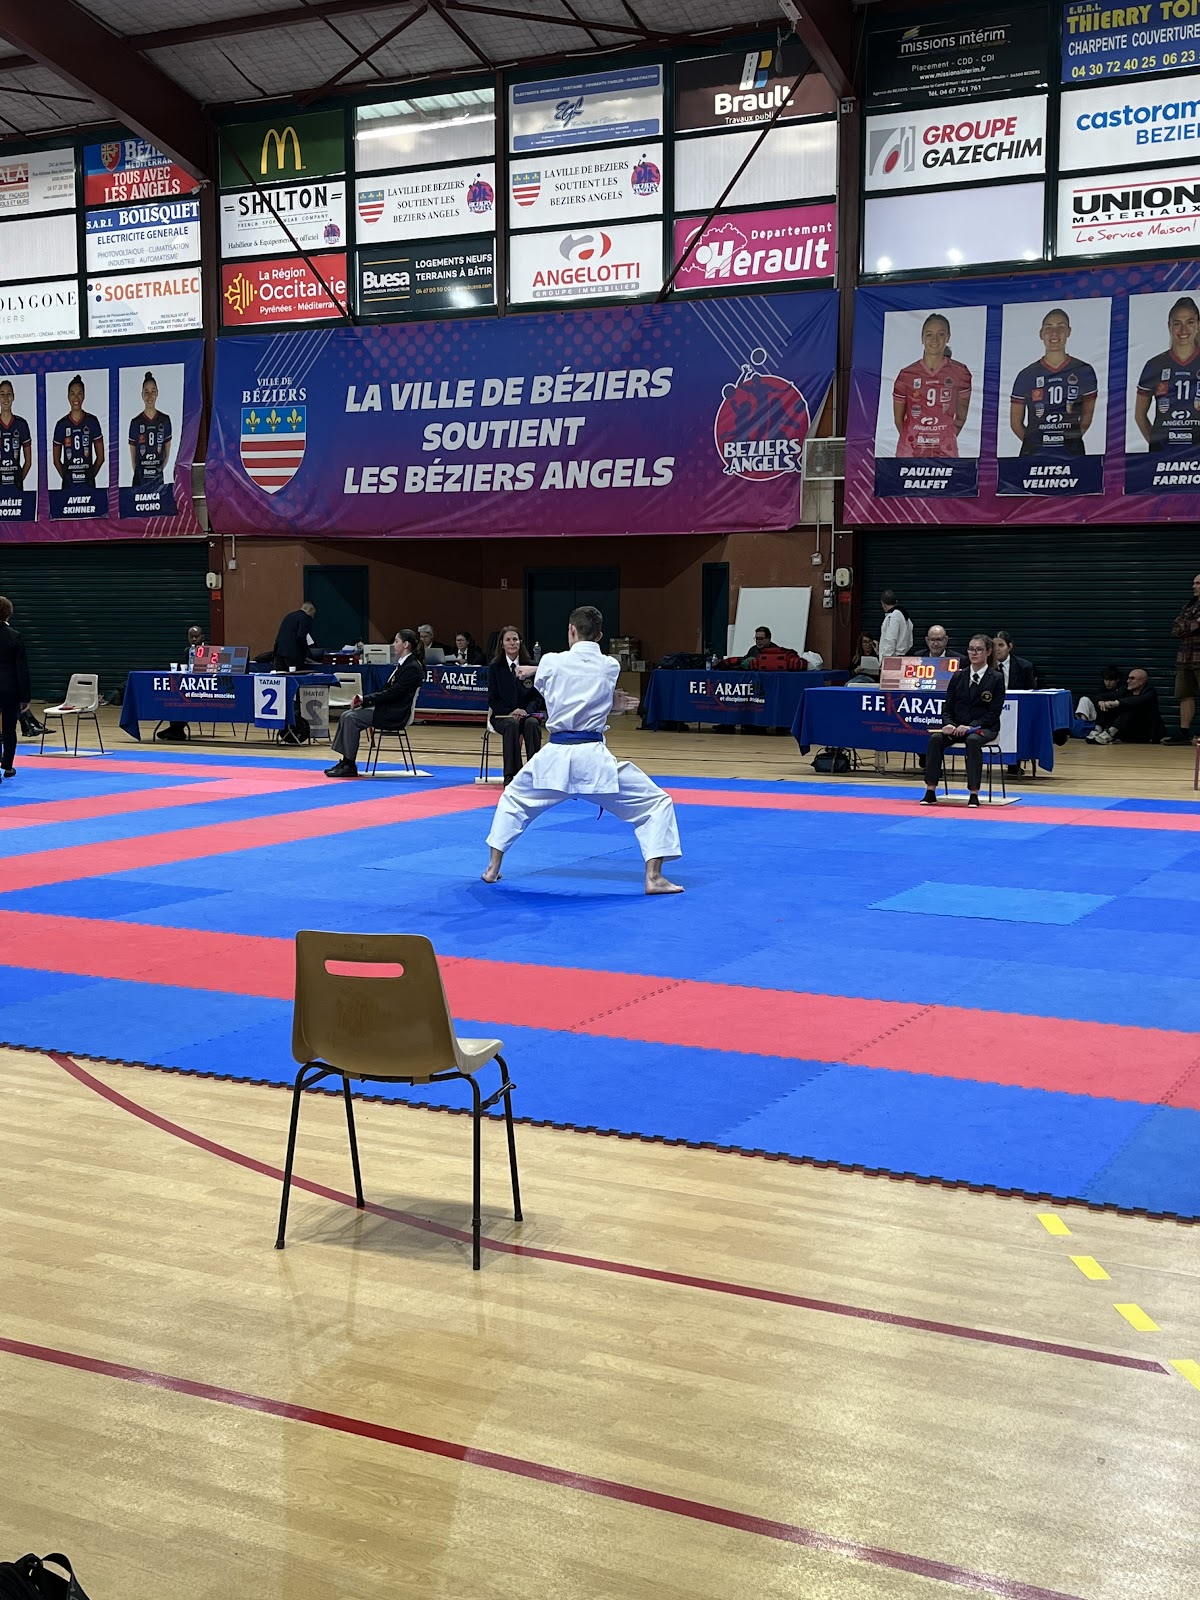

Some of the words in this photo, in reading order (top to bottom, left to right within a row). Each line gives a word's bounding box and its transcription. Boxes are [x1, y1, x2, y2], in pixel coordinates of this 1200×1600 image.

[1066, 4, 1152, 34] THIERRY
[1160, 0, 1200, 20] TOI
[901, 36, 956, 54] missions
[959, 29, 1005, 46] intérim
[1068, 34, 1127, 56] CHARPENTE
[1132, 23, 1200, 47] COUVERTURE
[911, 61, 949, 72] Placement
[957, 56, 973, 66] CDD
[981, 54, 994, 63] CDI
[1072, 65, 1086, 78] 04
[1089, 63, 1103, 76] 30
[1106, 61, 1121, 73] 72
[1124, 58, 1138, 71] 40
[1141, 56, 1156, 68] 25
[1162, 53, 1177, 65] 06
[1180, 50, 1195, 63] 23
[919, 66, 986, 80] www.missionsinterim.fr
[939, 87, 948, 96] 04
[948, 87, 957, 95] 67
[957, 86, 969, 94] 761
[970, 84, 981, 93] 761
[714, 84, 794, 115] Brault
[725, 115, 753, 125] Travaux
[923, 116, 1017, 145] GROUPE
[1136, 123, 1200, 145] BEZIE
[922, 138, 1042, 169] GAZECHIM
[113, 170, 141, 186] TOUS
[143, 166, 171, 181] AVEC
[544, 169, 555, 179] LA
[555, 166, 580, 177] VILLE
[581, 165, 593, 175] DE
[594, 160, 629, 173] BEZIERS
[105, 186, 128, 204] LES
[130, 179, 181, 201] ANGELS
[387, 188, 398, 197] LA
[398, 185, 421, 196] VILLE
[421, 184, 432, 193] DE
[433, 179, 465, 191] BEZIERS
[554, 178, 600, 192] SOUTIENT
[602, 176, 618, 187] LES
[238, 185, 328, 216] SHILTON
[397, 196, 440, 210] SOUTIENT
[441, 195, 455, 205] LES
[550, 194, 586, 207] BEZIERS
[587, 190, 623, 202] ANGELS
[1073, 184, 1200, 215] UNION
[119, 201, 200, 225] BOUSQUET
[237, 221, 259, 229] FRENCH
[301, 213, 329, 221] COMPANY
[393, 211, 426, 223] BEZIERS
[427, 208, 460, 220] ANGELS
[1072, 205, 1200, 224] MATERIAUX
[97, 231, 145, 245] ELECTRICITE
[147, 226, 189, 239] GENERALE
[299, 233, 319, 242] officiel
[1076, 230, 1095, 243] Le
[1097, 229, 1143, 241] Service
[148, 242, 190, 253] CLIMATISATION
[108, 258, 135, 267] INDUSTRIE
[140, 253, 178, 264] AUTOMATISME
[415, 256, 464, 269] LOGEMENTS
[465, 253, 493, 264] NEUFS
[259, 270, 270, 281] La
[272, 266, 306, 281] Région
[362, 271, 410, 289] Buesa
[415, 269, 457, 281] TERRAINS
[459, 266, 466, 278] À
[467, 265, 493, 277] BÂTIR
[532, 262, 640, 287] ANGELOTTI
[104, 277, 200, 301] SOGETRALEC
[260, 276, 346, 301] Occitanie
[535, 288, 573, 297] GROUPE
[578, 283, 636, 294] IMMOBILIER
[260, 304, 293, 316] Pyrénées
[256, 377, 280, 387] VILLE
[281, 376, 293, 385] DE
[345, 384, 382, 413] LA
[390, 379, 476, 411] VILLE
[480, 376, 525, 407] DE
[529, 365, 674, 405] BÉZIERS
[1174, 380, 1190, 400] 11
[242, 387, 307, 404] BÉZIERS
[926, 388, 936, 407] 9
[1047, 386, 1063, 405] 10
[148, 431, 155, 446] 8
[421, 416, 586, 451] SOUTIENT
[917, 435, 940, 443] Buesa
[1042, 434, 1064, 442] Buesa
[1168, 431, 1192, 439] Buesa
[4, 438, 10, 453] 5
[74, 435, 80, 450] 6
[723, 438, 801, 458] BEZIERS
[730, 454, 796, 473] ANGELS
[899, 467, 953, 477] PAULINE
[1029, 465, 1071, 476] ELITSA
[343, 465, 399, 494] LES
[403, 457, 536, 494] BÉZIERS
[539, 456, 676, 490] ANGELS
[1022, 478, 1079, 489] VELINOV
[903, 479, 948, 489] BALFET
[67, 495, 91, 505] AVERY
[134, 492, 161, 501] BIANCA
[63, 505, 96, 515] SKINNER
[135, 502, 161, 512] CUGNO
[196, 646, 204, 658] 0
[211, 652, 218, 664] 2
[947, 658, 958, 672] 0
[260, 688, 278, 715] 2
[861, 694, 946, 715] F.F.KARAT
